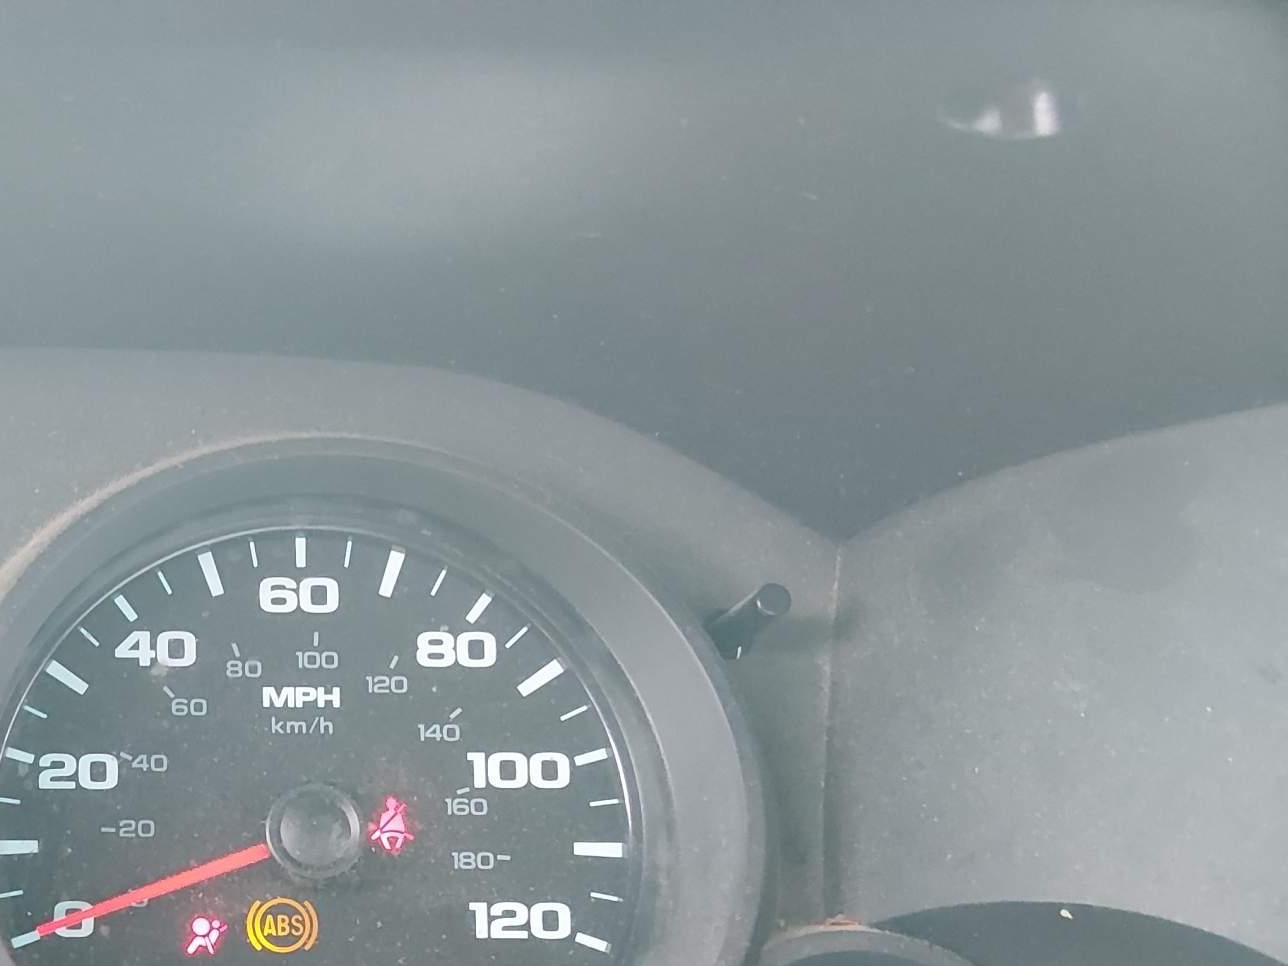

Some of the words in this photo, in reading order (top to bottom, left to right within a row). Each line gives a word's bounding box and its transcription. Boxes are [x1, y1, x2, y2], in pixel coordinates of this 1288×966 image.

[259, 577, 340, 614] 60
[115, 631, 197, 666] 40
[416, 631, 496, 667] 80
[226, 659, 262, 678] 80
[296, 651, 339, 669] 100
[365, 676, 408, 694] 120
[171, 697, 207, 716] 60
[262, 687, 340, 708] MPH
[271, 716, 334, 734] km/h
[418, 723, 460, 742] 140
[38, 753, 118, 789] 20
[131, 754, 168, 772] 40
[466, 752, 570, 789] 100
[445, 797, 487, 815] 160
[119, 819, 155, 837] 20
[452, 851, 494, 870] 180
[53, 900, 94, 938] 0
[263, 914, 304, 937] ABS
[468, 901, 571, 940] 120
